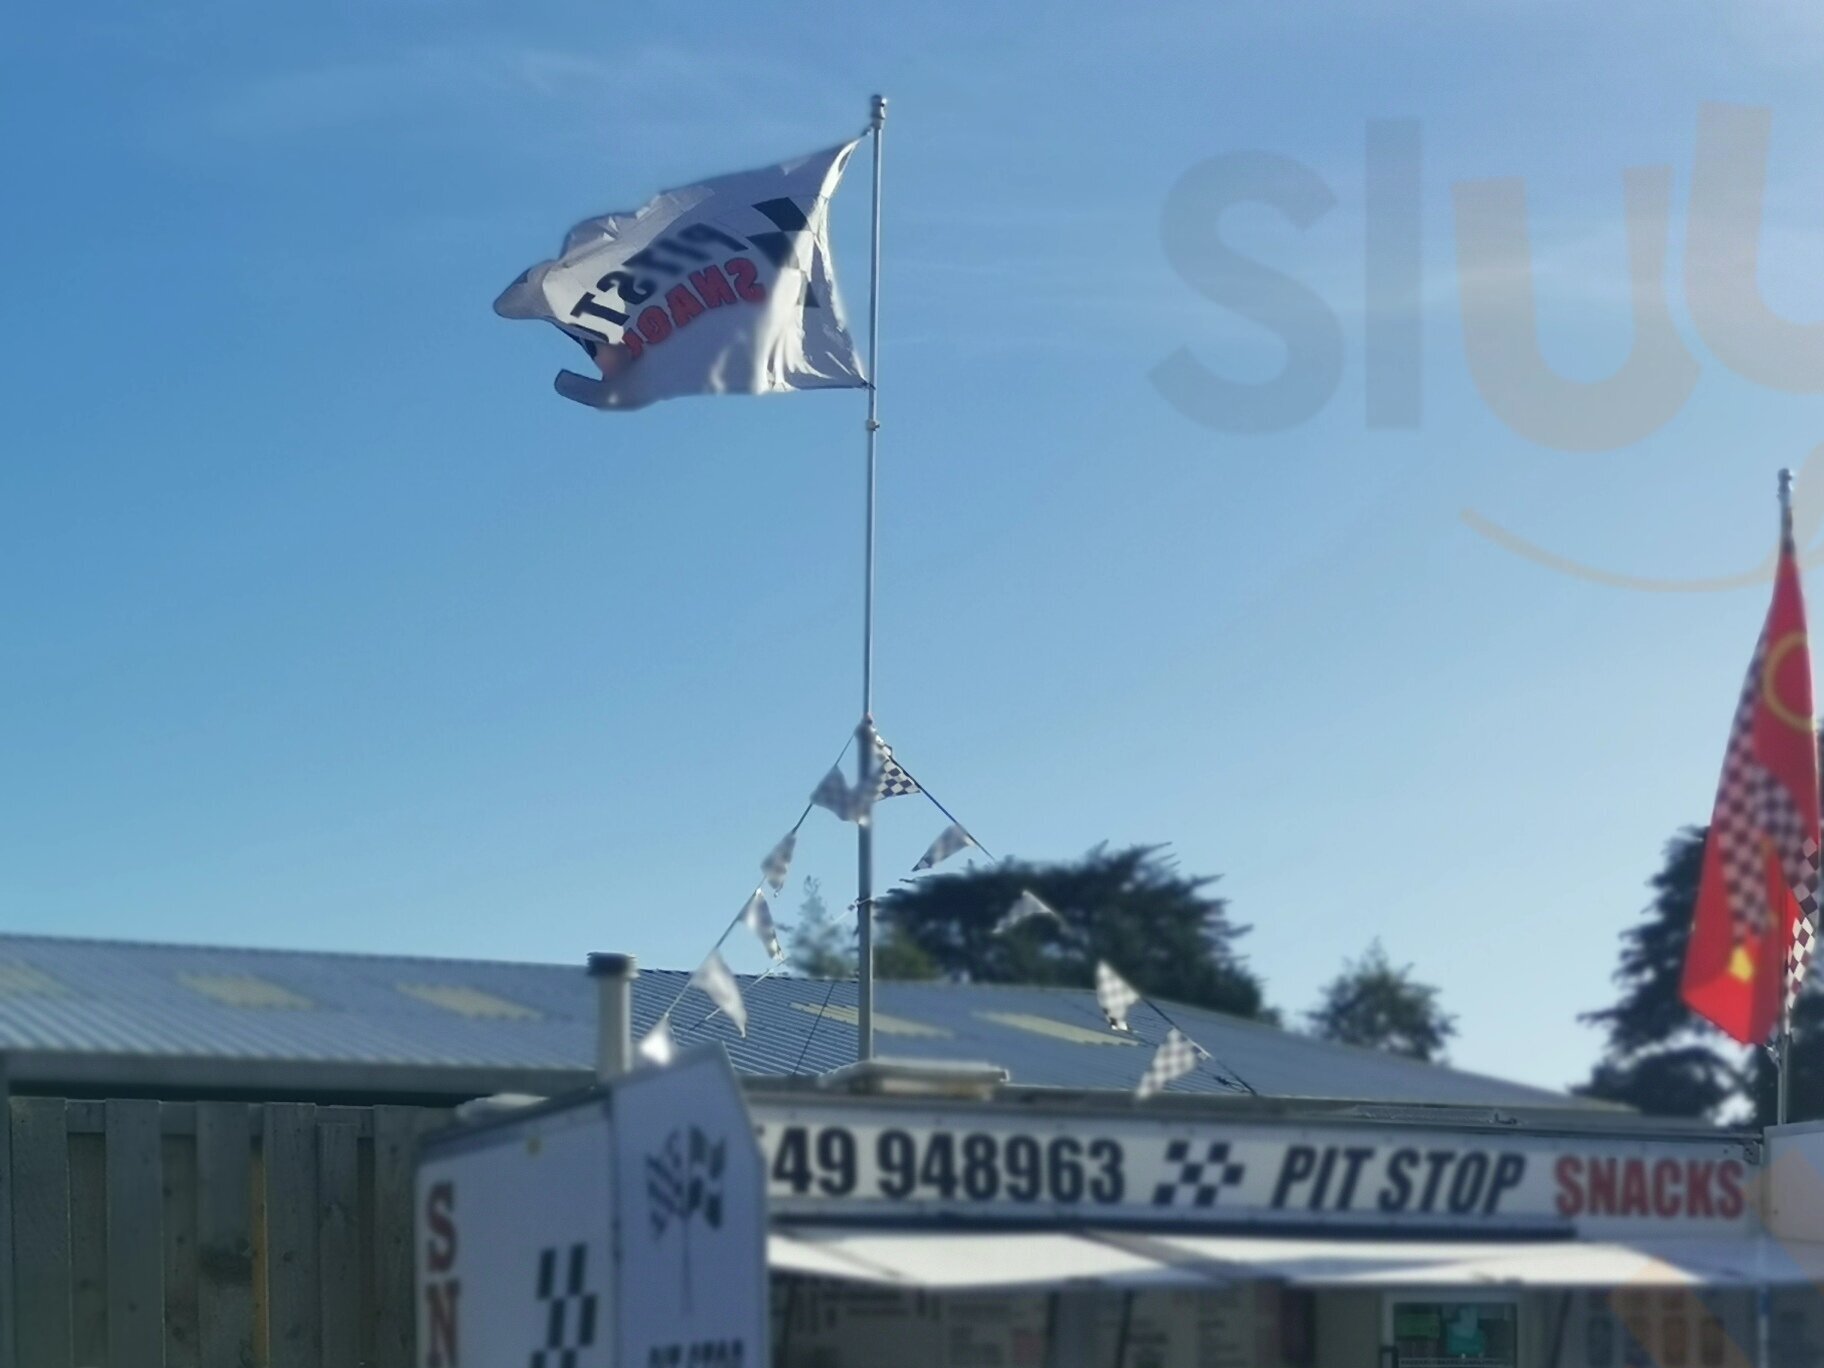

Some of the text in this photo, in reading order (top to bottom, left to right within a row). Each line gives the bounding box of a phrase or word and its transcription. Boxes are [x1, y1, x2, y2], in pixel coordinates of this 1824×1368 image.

[757, 1124, 1745, 1220] 49 948963 PIT STOP SNACKS
